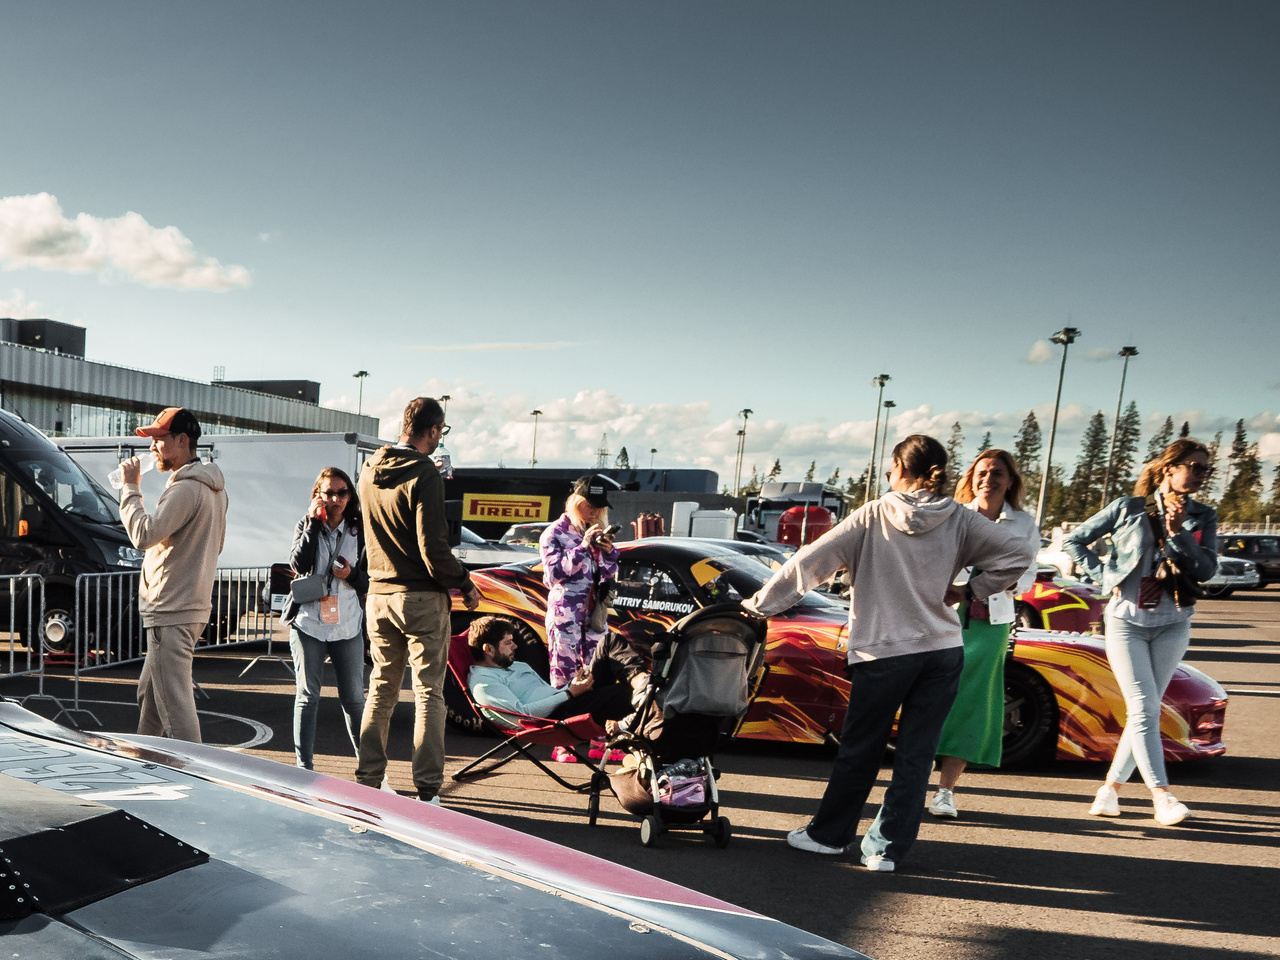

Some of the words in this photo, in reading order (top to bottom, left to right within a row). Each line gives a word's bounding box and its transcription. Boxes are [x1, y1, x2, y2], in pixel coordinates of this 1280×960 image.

[469, 499, 542, 518] PIRELLI
[612, 596, 642, 608] MITRIY
[642, 599, 694, 613] SAMORUKOV
